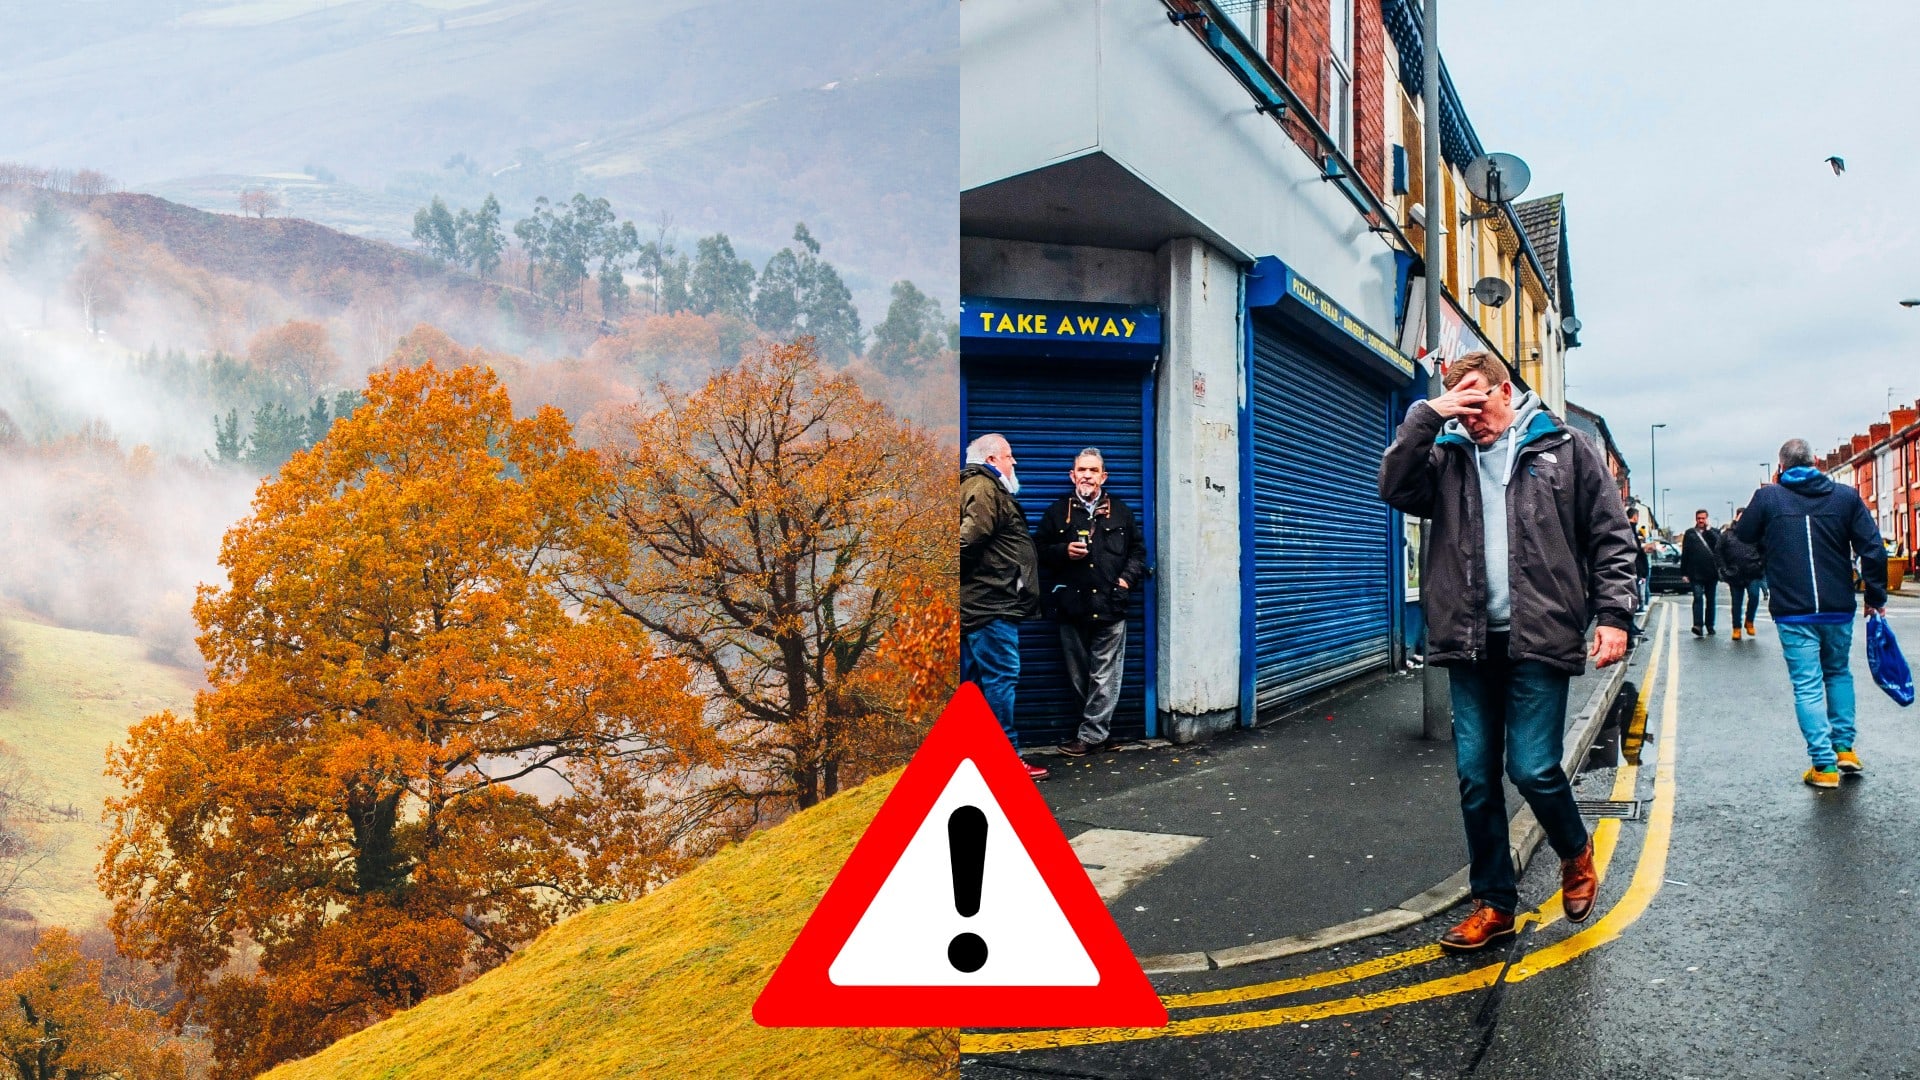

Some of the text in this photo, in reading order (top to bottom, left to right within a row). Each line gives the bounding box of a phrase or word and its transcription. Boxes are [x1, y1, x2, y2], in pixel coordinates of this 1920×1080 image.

[1292, 278, 1316, 306] PIZZAS
[979, 312, 1136, 338] TAKE AWAY
